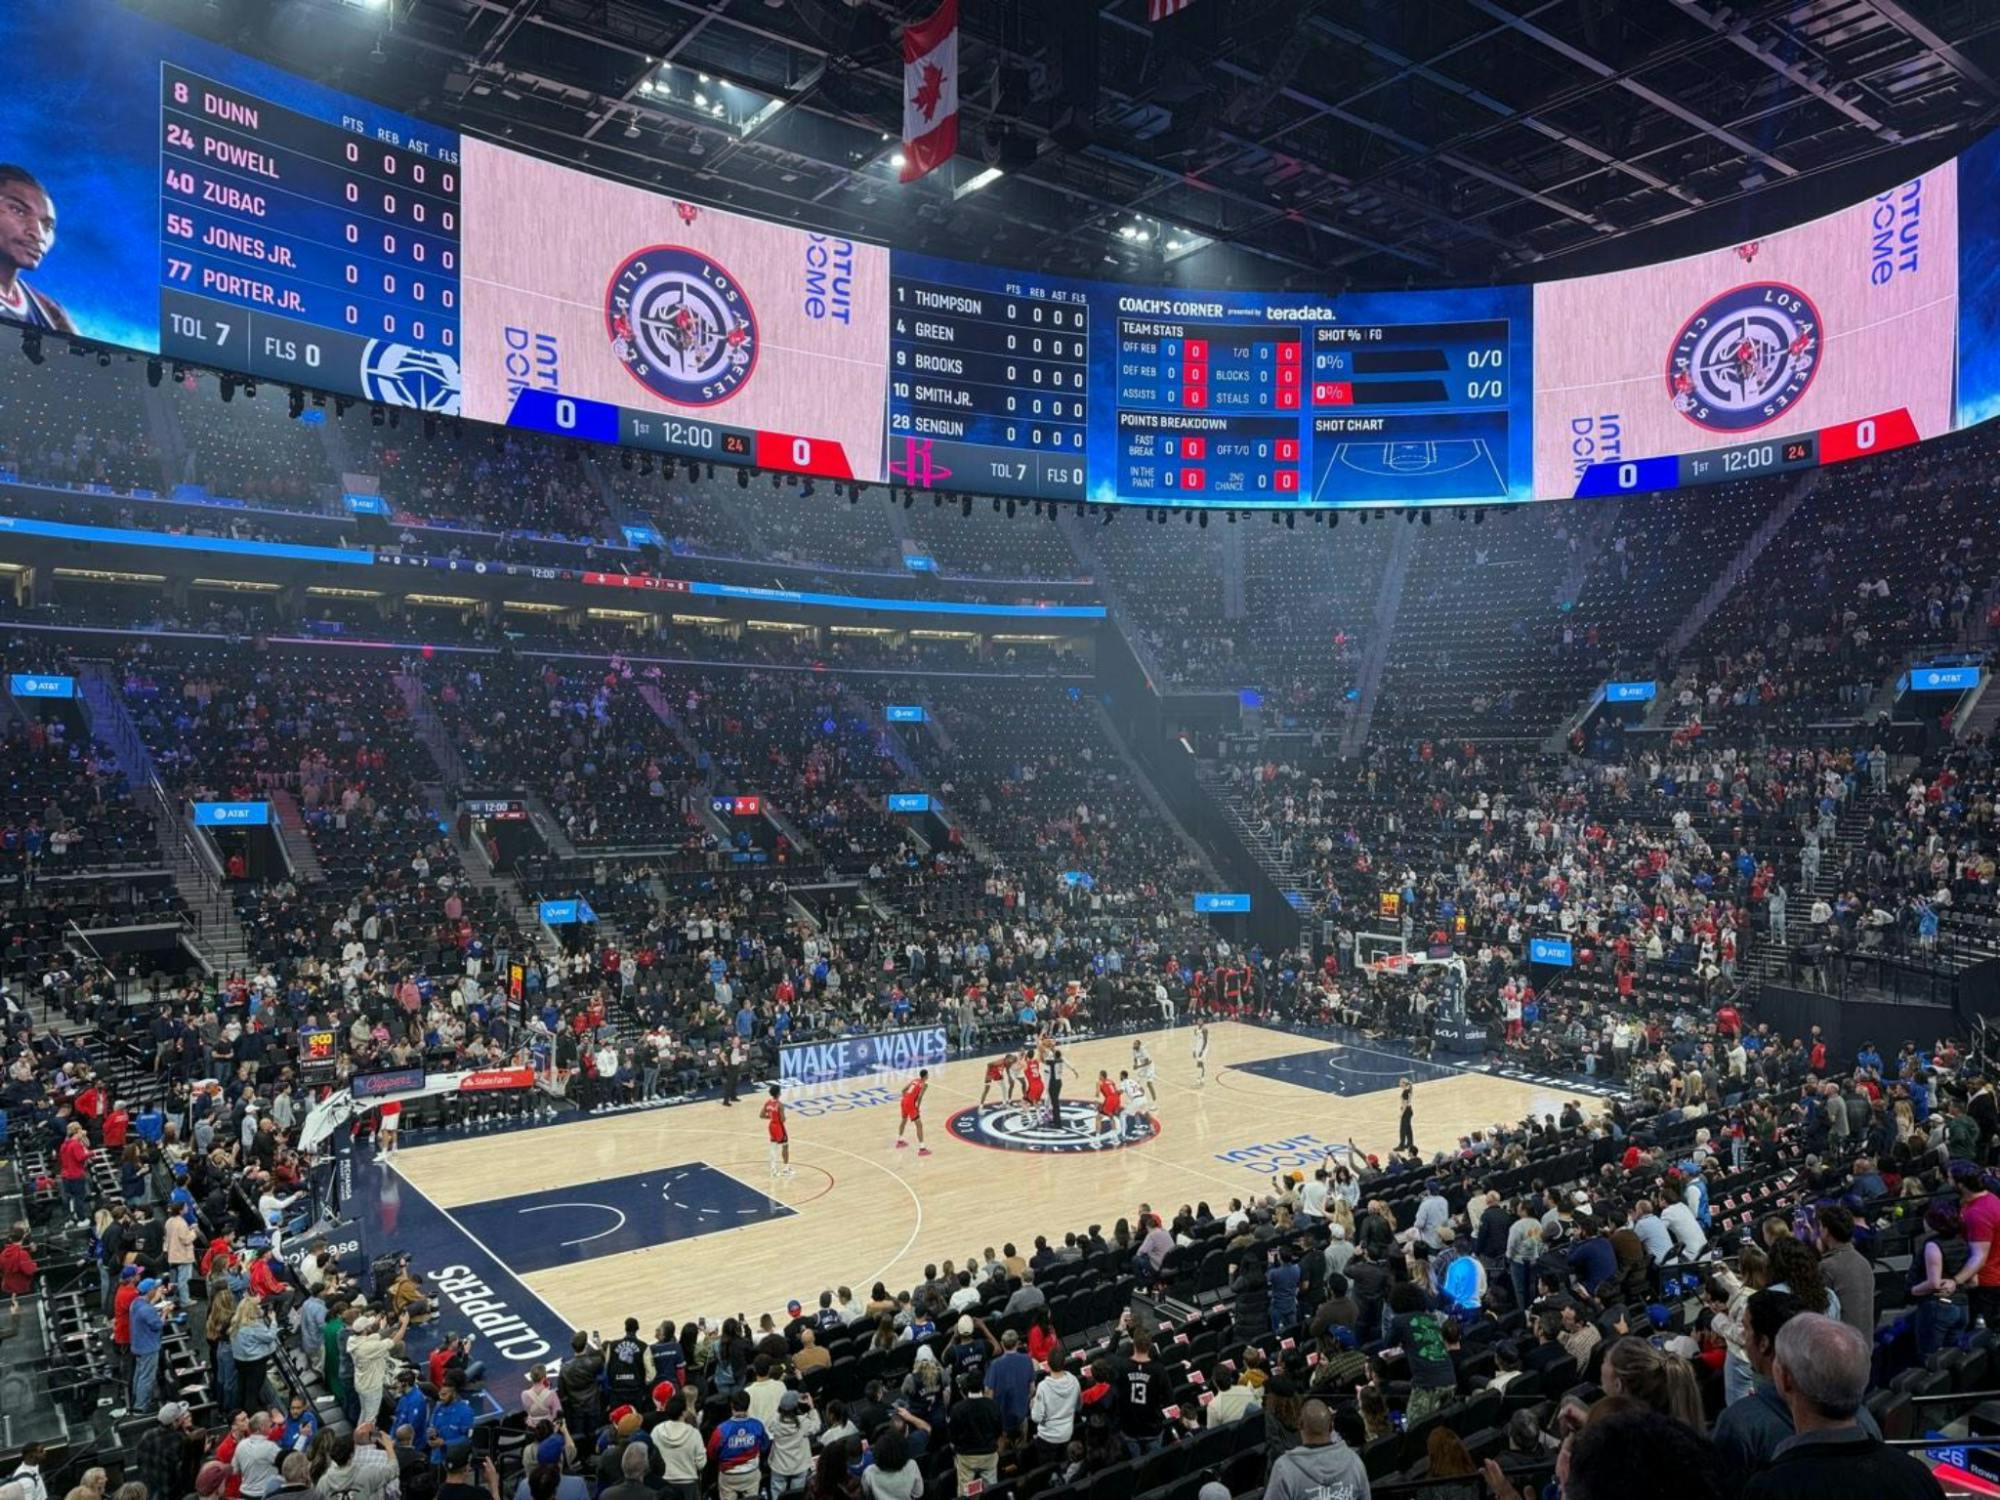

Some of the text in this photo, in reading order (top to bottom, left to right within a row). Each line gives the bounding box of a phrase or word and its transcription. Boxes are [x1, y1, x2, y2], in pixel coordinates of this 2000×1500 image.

[174, 82, 454, 192] 8 DUNN 0 0 0 0
[343, 116, 458, 164] PTS REB AST FLS
[167, 124, 396, 213] 24 POWELL 0 0
[166, 168, 396, 253] 40 ZUBAC 0 0
[166, 213, 396, 293] 55 JONES JR. 0 0
[702, 265, 739, 303] LOS
[1006, 284, 1086, 303] PTS REB AST FLS
[167, 258, 454, 346] 77 PORTER JR. 0 0 0 0
[897, 288, 1083, 327] 1 THOMPSON 0 0 0 0
[1119, 298, 1171, 315] COACH'S
[1173, 302, 1223, 317] CORNER
[1764, 290, 1801, 314] LOS
[896, 319, 1042, 352] 4 GREEN 0 0
[1123, 322, 1184, 337] TEAM STATS
[1318, 328, 1383, 341] SHOT % FG
[170, 313, 320, 367] TOL 7 FLS 0
[1123, 342, 1157, 354] OFF REB
[1233, 347, 1249, 358] T/O
[1316, 350, 1502, 369] 0% 0/0
[896, 351, 1042, 383] 9 BROOKS 0 0
[1140, 366, 1157, 377] REB
[1216, 370, 1250, 381] BLOCKS
[893, 383, 1042, 413] 10 SMITH JR. 0 0
[1123, 389, 1156, 400] ASSISTS
[1216, 393, 1250, 404] STEALS
[1316, 380, 1502, 400] 0% 0/0
[892, 414, 1083, 447] 28 SENGUN 0 0 0 0
[1121, 414, 1227, 430] POINTS BREAKDOWN
[1315, 419, 1384, 431] SHOT CHART
[556, 400, 811, 466] 0 1ST 12:00 24 0
[1134, 435, 1154, 445] FAST
[1129, 446, 1155, 456] BREAK
[1217, 445, 1250, 455] OFF T/O
[1619, 420, 1875, 489] 0 1ST 12:00 24 0
[990, 463, 1083, 485] TOL 7 FLS 0
[1132, 477, 1155, 488] PAINT
[531, 568, 555, 579] 12:00
[1941, 674, 1962, 683] AT&T
[1628, 688, 1644, 696] AT&T
[227, 809, 250, 818] AT&T
[484, 802, 508, 812] 12:00
[1548, 949, 1567, 958] AT&T
[310, 1045, 328, 1057] 24
[779, 1027, 947, 1081] MAKE WAVES
[427, 1264, 551, 1361] CLIPPERS
[1131, 1382, 1147, 1405] 13
[926, 1395, 936, 1412] 7
[1938, 1447, 1964, 1468] 26
